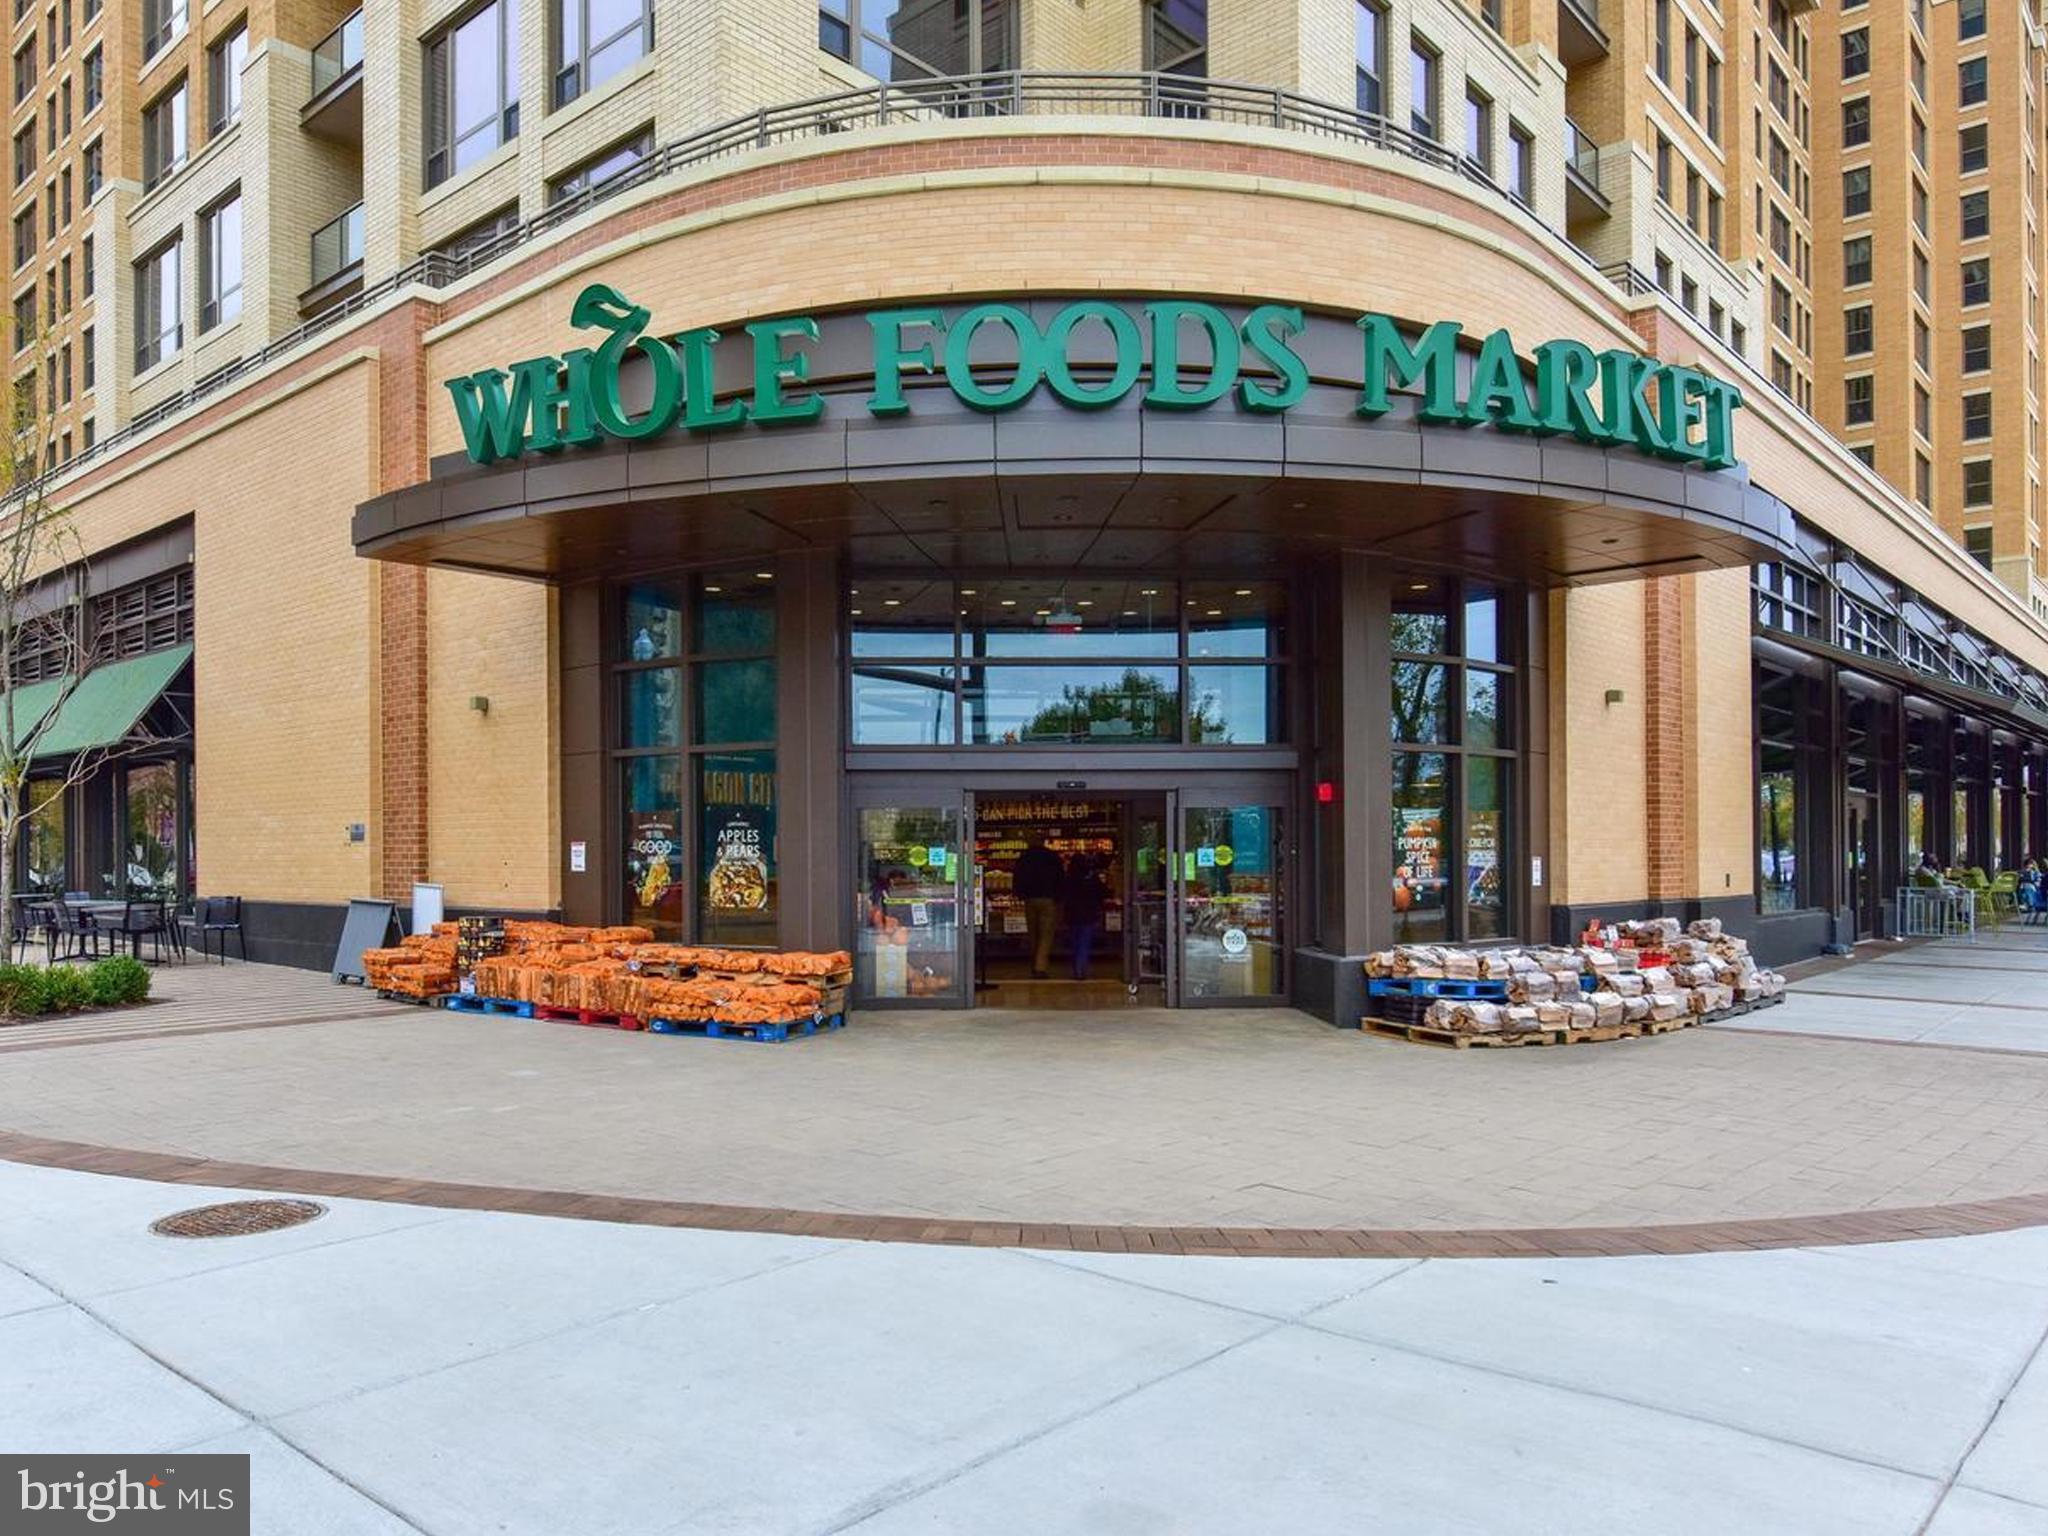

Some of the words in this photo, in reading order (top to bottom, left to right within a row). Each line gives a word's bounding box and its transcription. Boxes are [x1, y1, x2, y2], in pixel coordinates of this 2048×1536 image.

[444, 285, 825, 464] WHOLE
[866, 301, 1308, 414] FOODS
[1356, 311, 1742, 472] MARKET
[717, 829, 760, 843] APPLES
[638, 840, 673, 855] GOOD
[1398, 837, 1438, 850] PUMPKIN
[726, 844, 761, 858] PEARS
[1404, 851, 1431, 864] SPICE
[1416, 865, 1434, 878] LIFE
